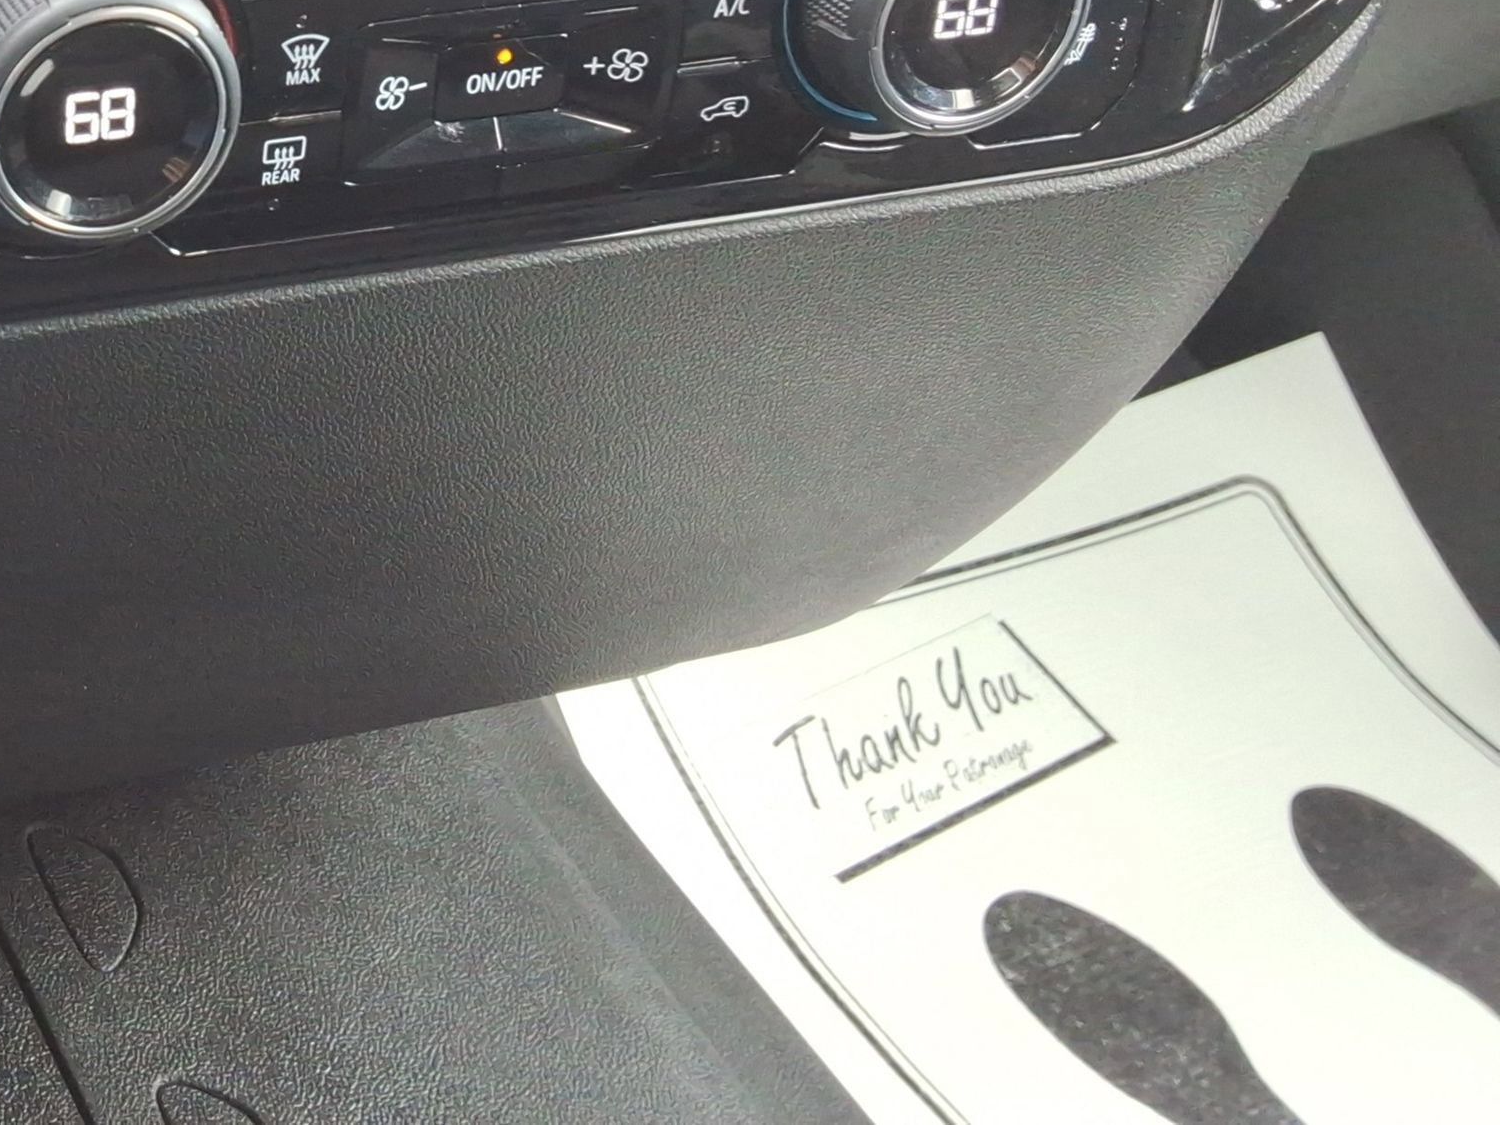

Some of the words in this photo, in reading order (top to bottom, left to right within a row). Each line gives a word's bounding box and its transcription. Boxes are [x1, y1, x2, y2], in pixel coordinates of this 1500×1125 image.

[285, 67, 321, 86] MAX
[465, 65, 544, 96] ON/OFF
[65, 87, 136, 145] 68
[261, 166, 301, 187] REAR
[773, 676, 940, 810] Thank
[934, 646, 1033, 732] You
[865, 796, 900, 832] For
[900, 778, 945, 813] Your
[943, 739, 1034, 792] Patronage
